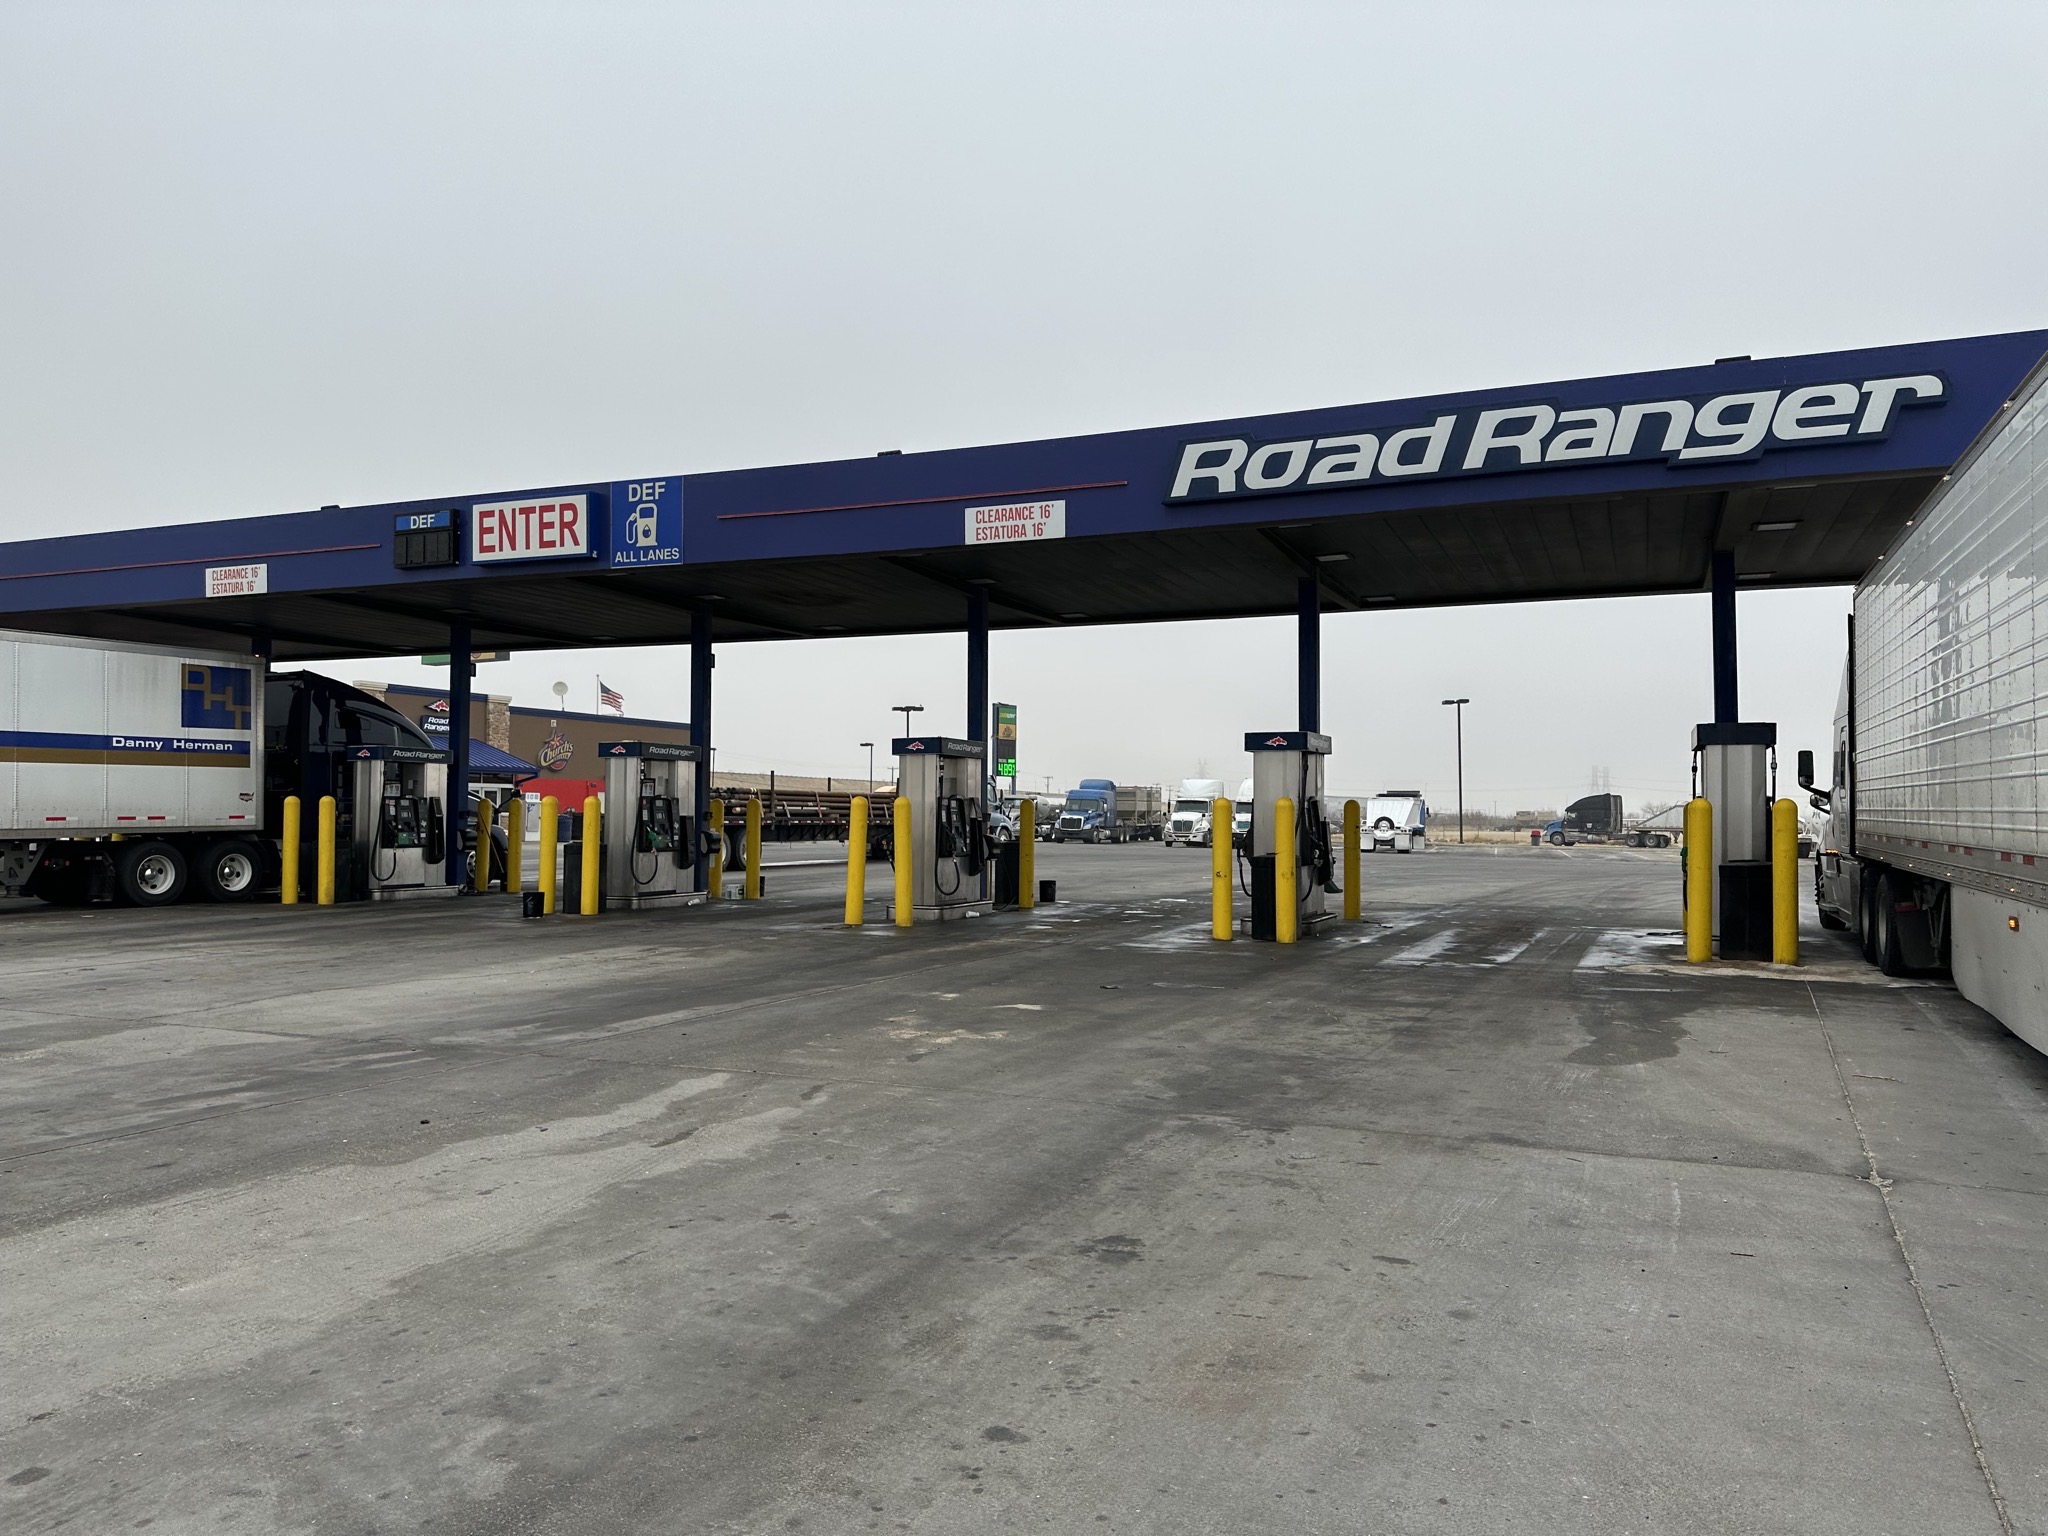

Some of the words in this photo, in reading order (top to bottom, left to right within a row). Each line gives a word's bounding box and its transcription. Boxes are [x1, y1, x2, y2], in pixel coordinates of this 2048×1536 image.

[1170, 415, 1457, 498] Road
[1461, 374, 1945, 470] Ranger
[628, 481, 666, 502] DEF
[410, 514, 435, 529] DEF
[975, 505, 1035, 524] CLEARANCE
[478, 502, 580, 554] ENTER
[975, 523, 1027, 541] ESTATURA
[615, 549, 636, 563] ALL
[640, 547, 680, 562] LANES
[212, 567, 248, 582] CLEARANCE
[212, 581, 244, 595] ESTATURA
[112, 737, 164, 751] Danny
[173, 739, 233, 751] Herman
[649, 746, 669, 754] Road
[392, 750, 415, 758] Road
[415, 751, 446, 760] Ranger
